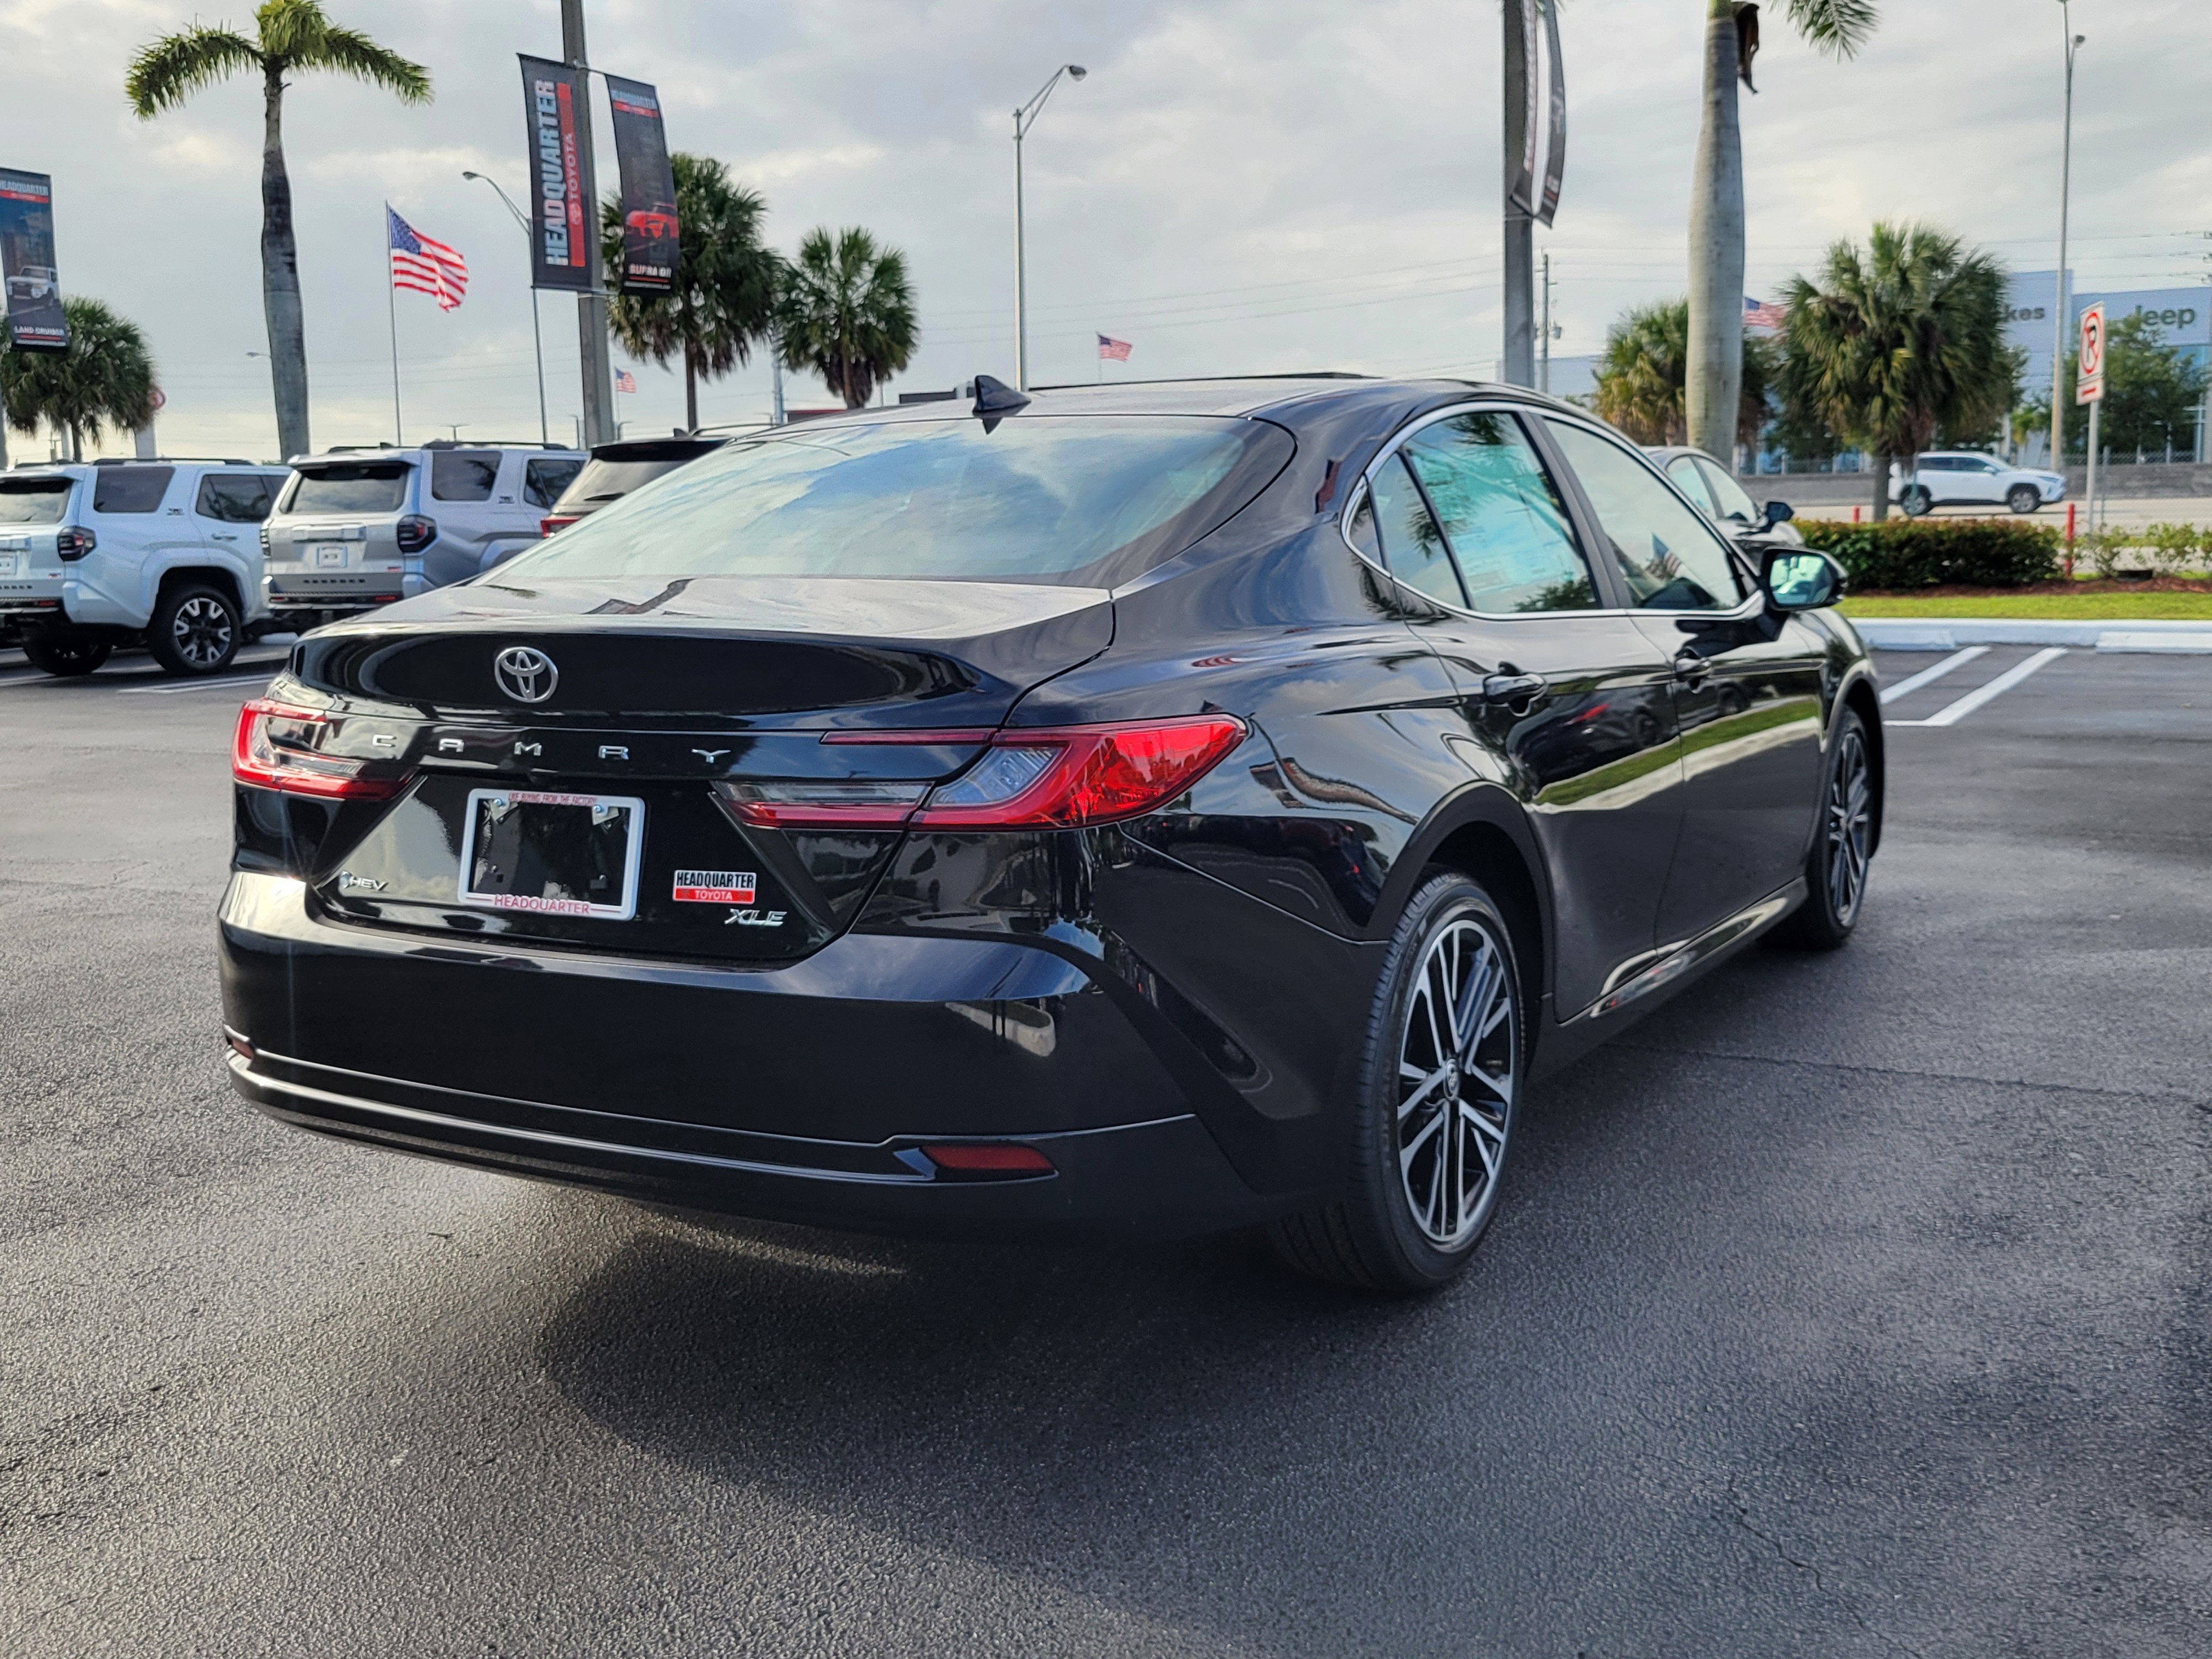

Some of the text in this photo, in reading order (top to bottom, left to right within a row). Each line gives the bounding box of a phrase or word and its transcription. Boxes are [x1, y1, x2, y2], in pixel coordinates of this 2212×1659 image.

[534, 79, 569, 266] HEADQUARTER
[566, 132, 579, 201] TOYOTA
[14, 325, 34, 334] LAND
[372, 733, 731, 763] CAMRY
[349, 876, 390, 890] HEV
[676, 871, 754, 889] HEADQUARTER
[495, 894, 589, 914] HEADQUARTER
[695, 890, 732, 900] TOYOTA
[724, 909, 787, 927] XLE
